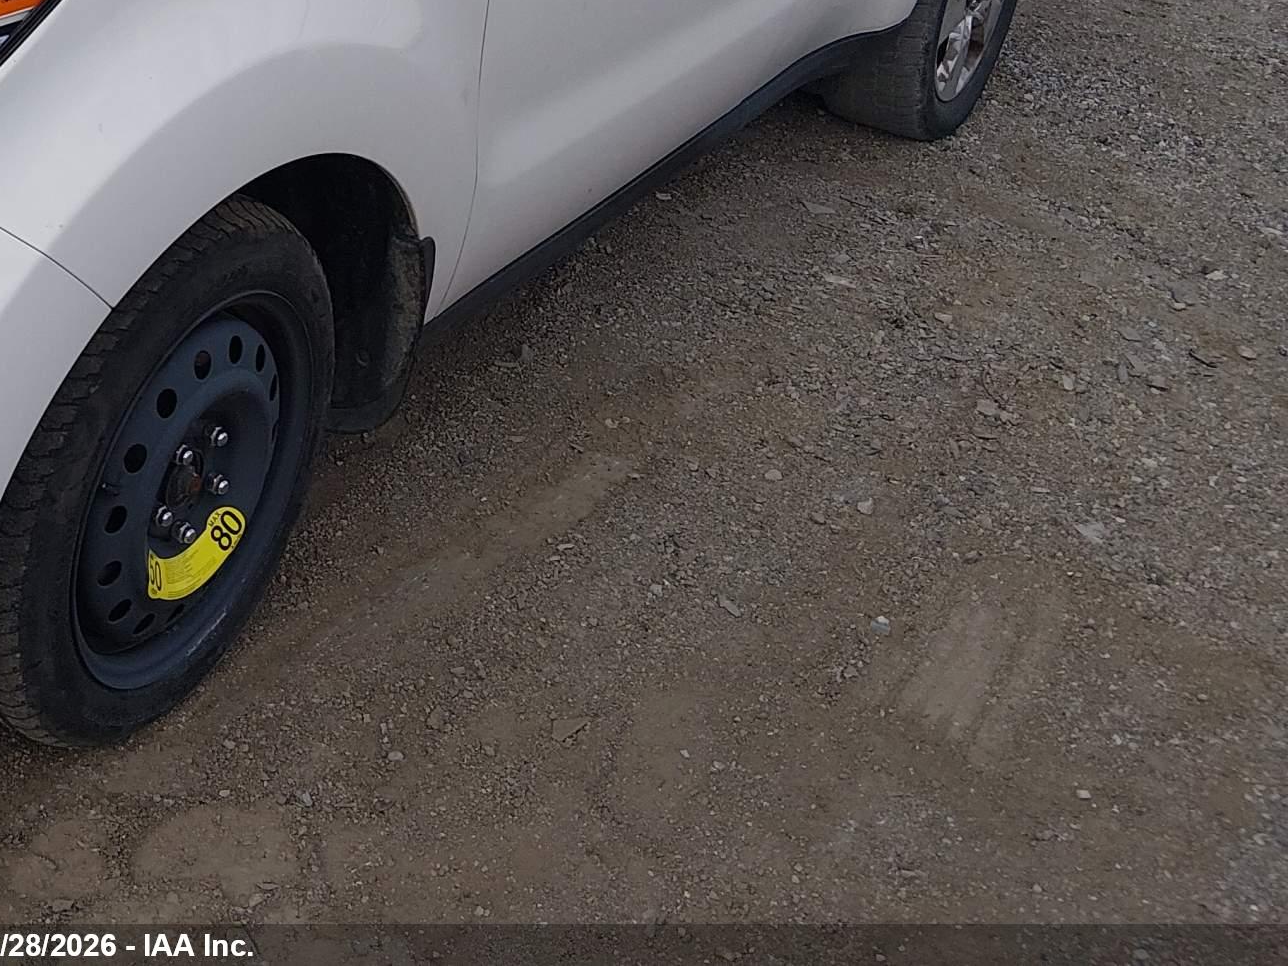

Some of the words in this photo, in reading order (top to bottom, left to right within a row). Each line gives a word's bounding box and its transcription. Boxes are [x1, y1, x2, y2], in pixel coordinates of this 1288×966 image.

[208, 511, 222, 527] MAX
[211, 511, 242, 550] 80
[150, 560, 162, 592] 50
